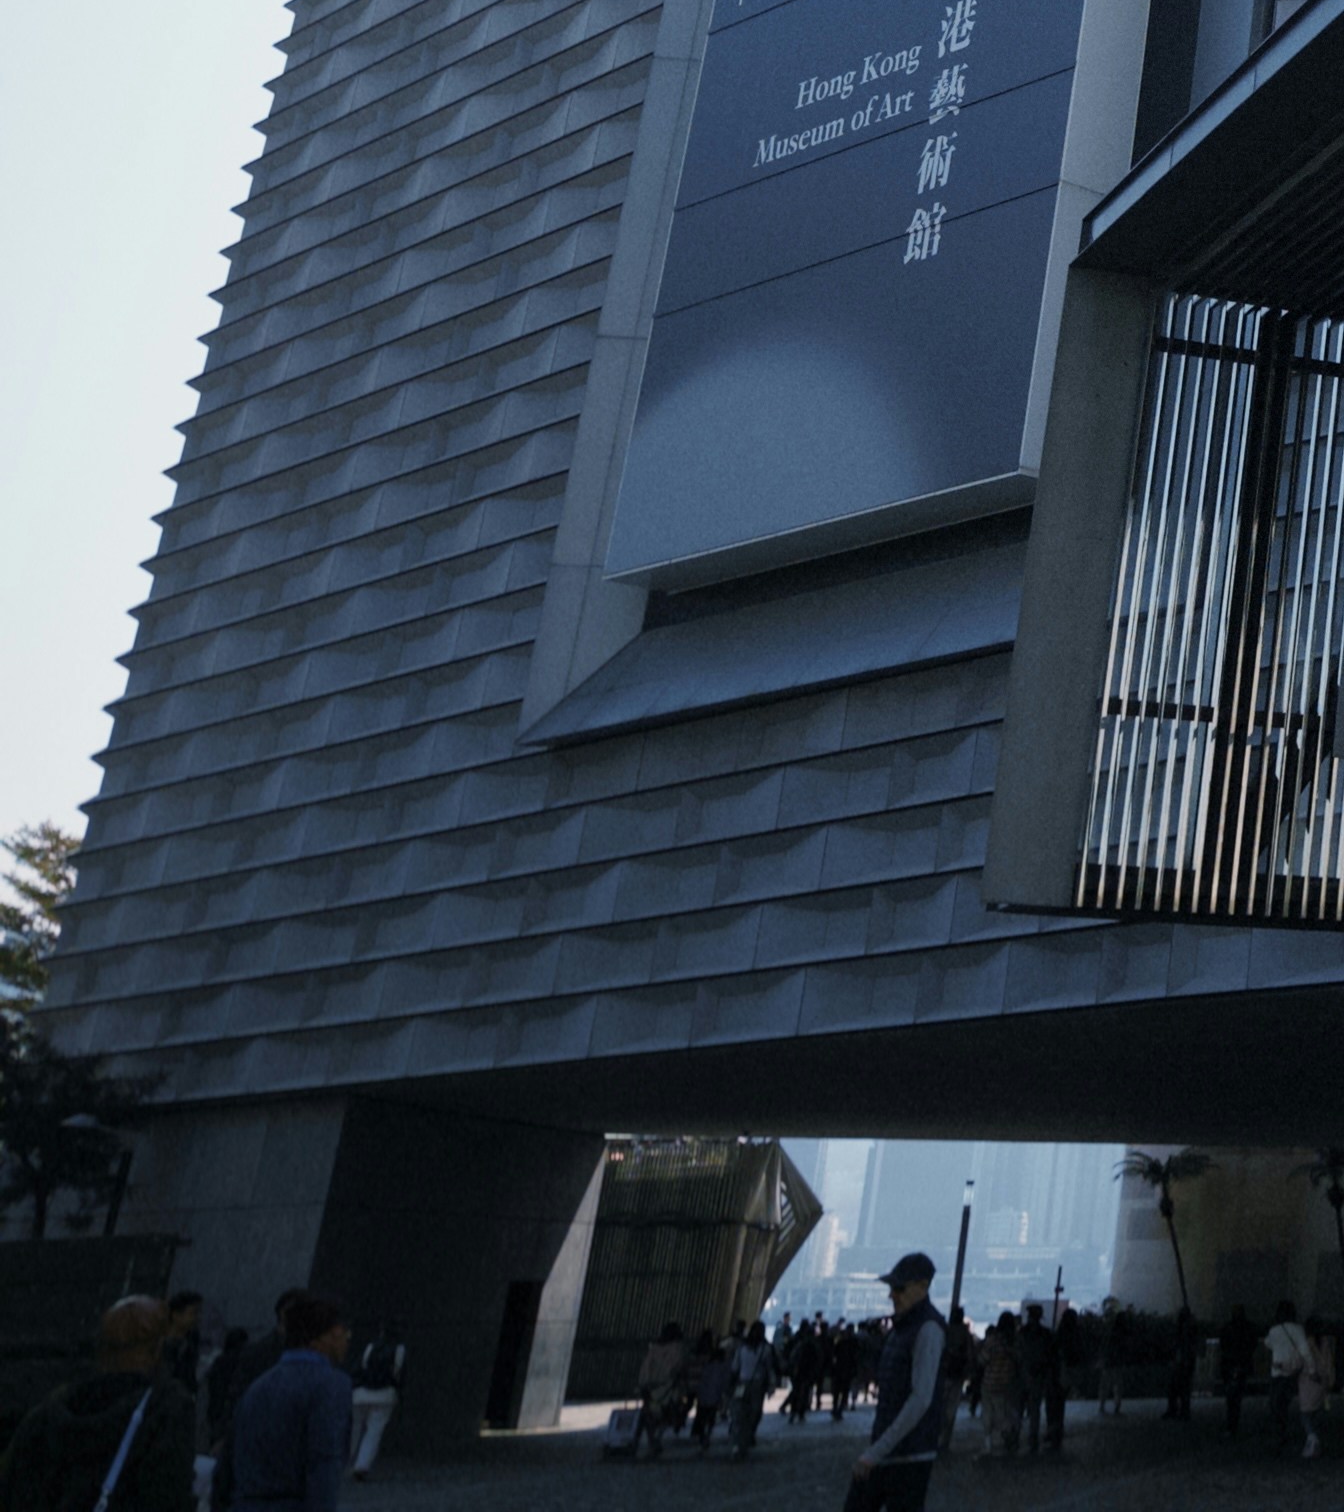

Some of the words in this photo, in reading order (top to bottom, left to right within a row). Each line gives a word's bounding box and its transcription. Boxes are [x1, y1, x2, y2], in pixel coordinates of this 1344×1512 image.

[796, 69, 857, 110] Hong
[861, 44, 922, 87] Kong
[752, 116, 845, 168] Museum
[850, 96, 880, 131] of
[874, 89, 916, 125] Art
